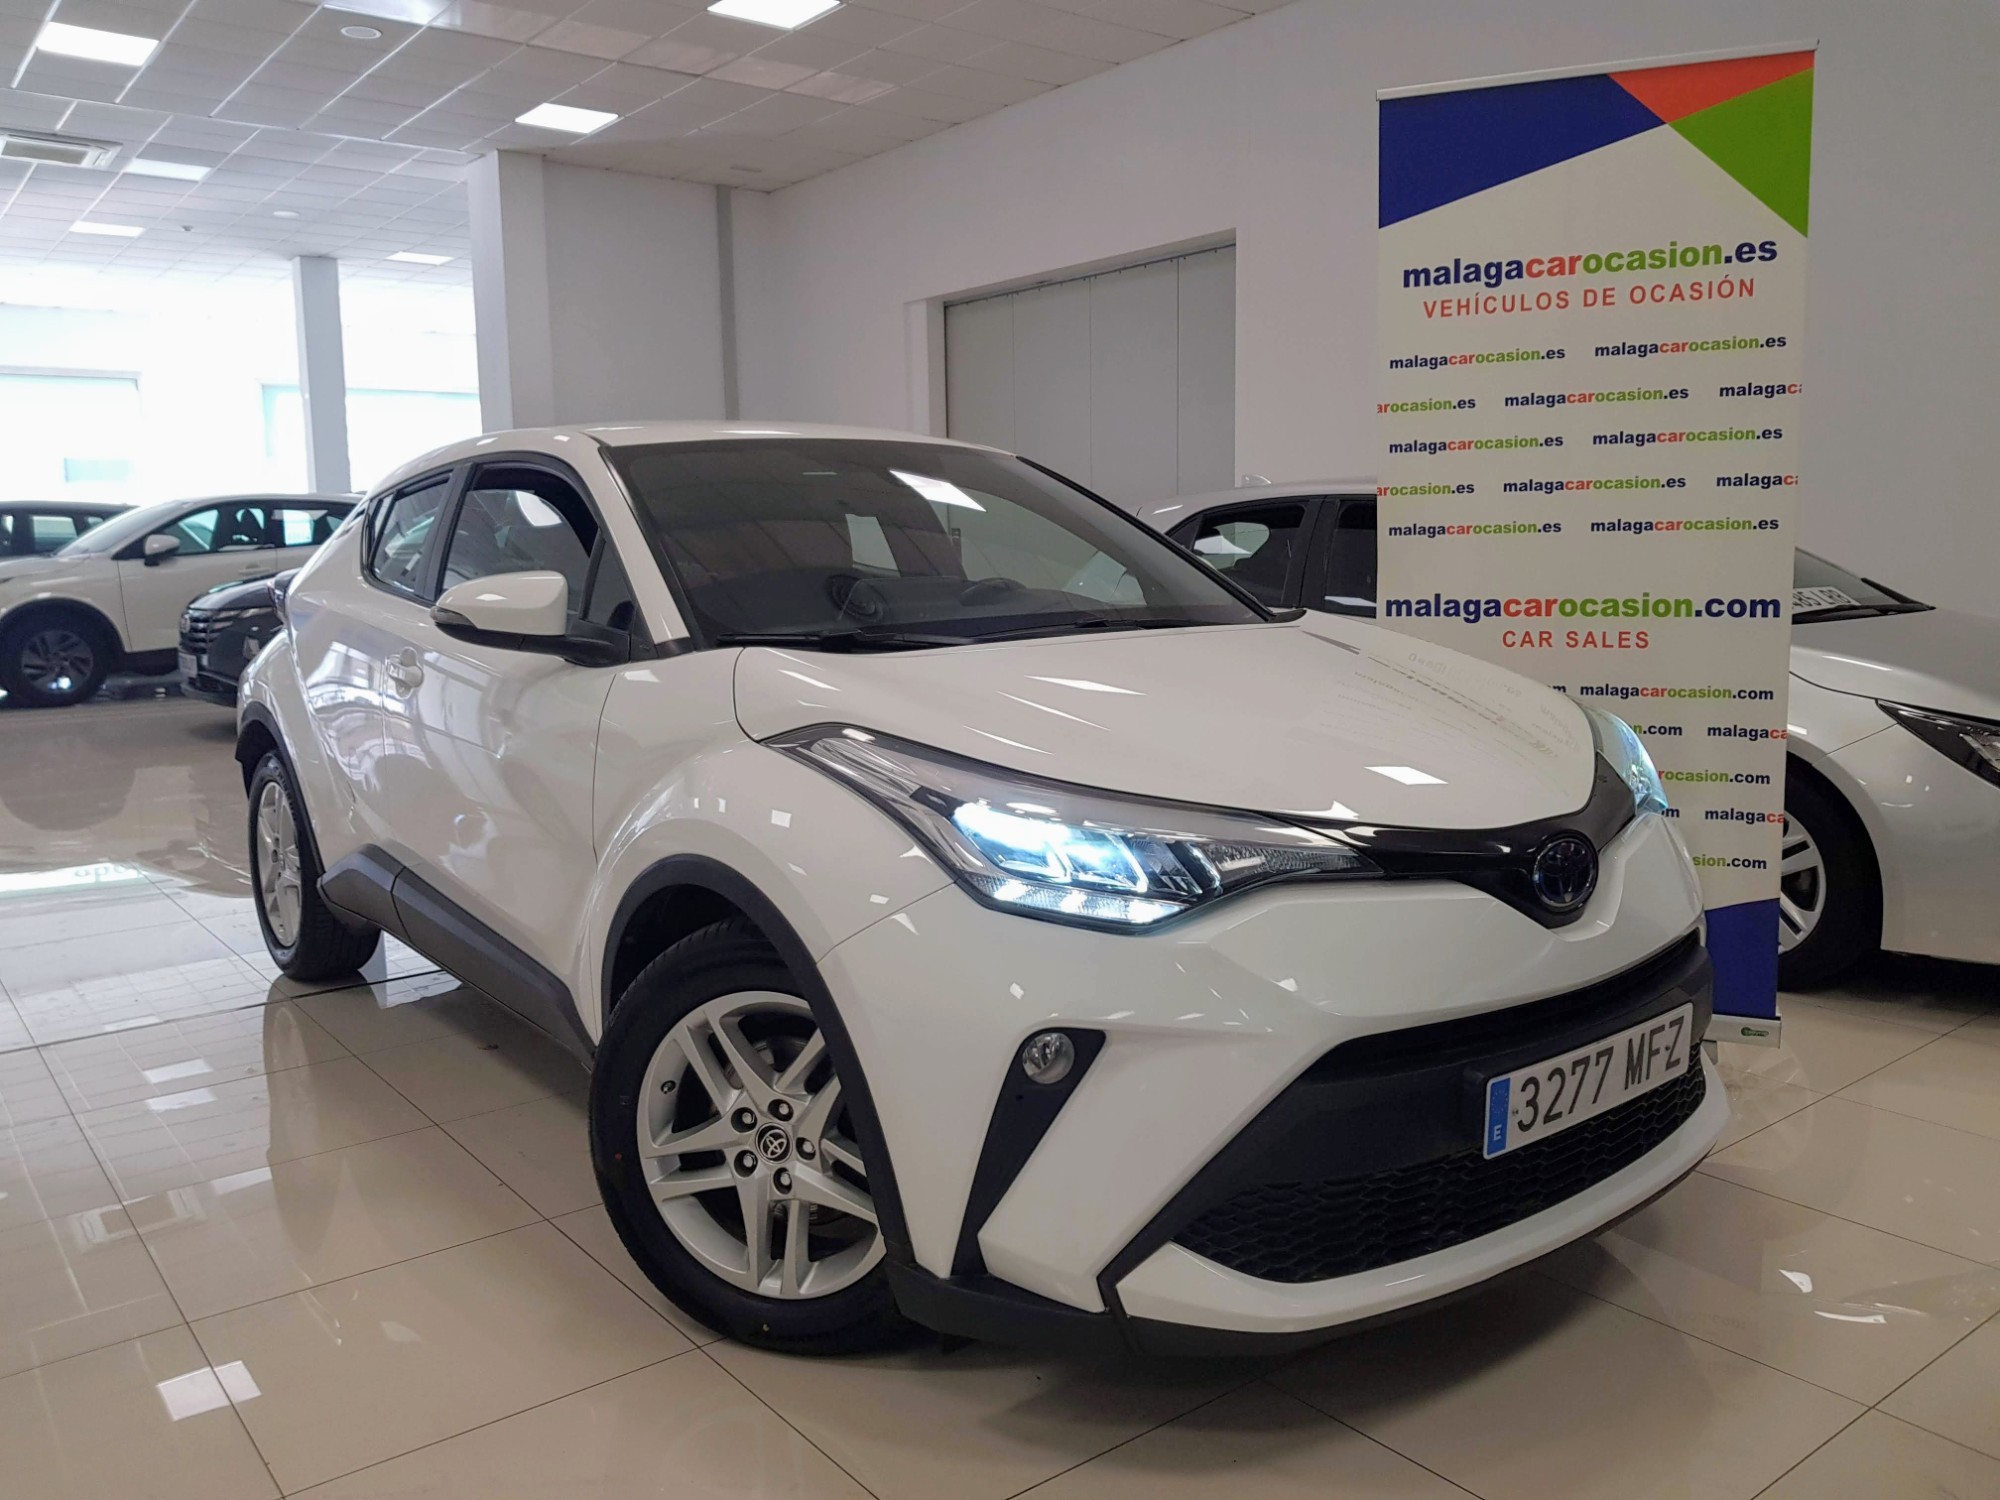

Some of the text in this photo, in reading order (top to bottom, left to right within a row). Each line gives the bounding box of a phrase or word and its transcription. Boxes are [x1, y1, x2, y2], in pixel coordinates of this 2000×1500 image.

[1402, 240, 1778, 288] malagacarocasion.es
[1423, 274, 1755, 318] VEHÍCULOS DE OCASIÓN
[1389, 334, 1787, 370] malagacarocasion.es malagacarocasion.es
[1504, 386, 1690, 408] malagacarocasion.es
[1389, 426, 1783, 454] malagacarocasion.es malagacarocasion.es
[1503, 475, 1687, 494] malagacarocasion.es
[1388, 516, 1780, 538] malagacarocasion.es malagacarocasion.es
[1385, 592, 1781, 624] malagacarocasion.com
[1502, 630, 1650, 649] CAR SALES
[1580, 683, 1774, 700] malagacarocasion.com
[1516, 1014, 1685, 1133] 3277 MFZ
[1493, 1124, 1502, 1141] E
